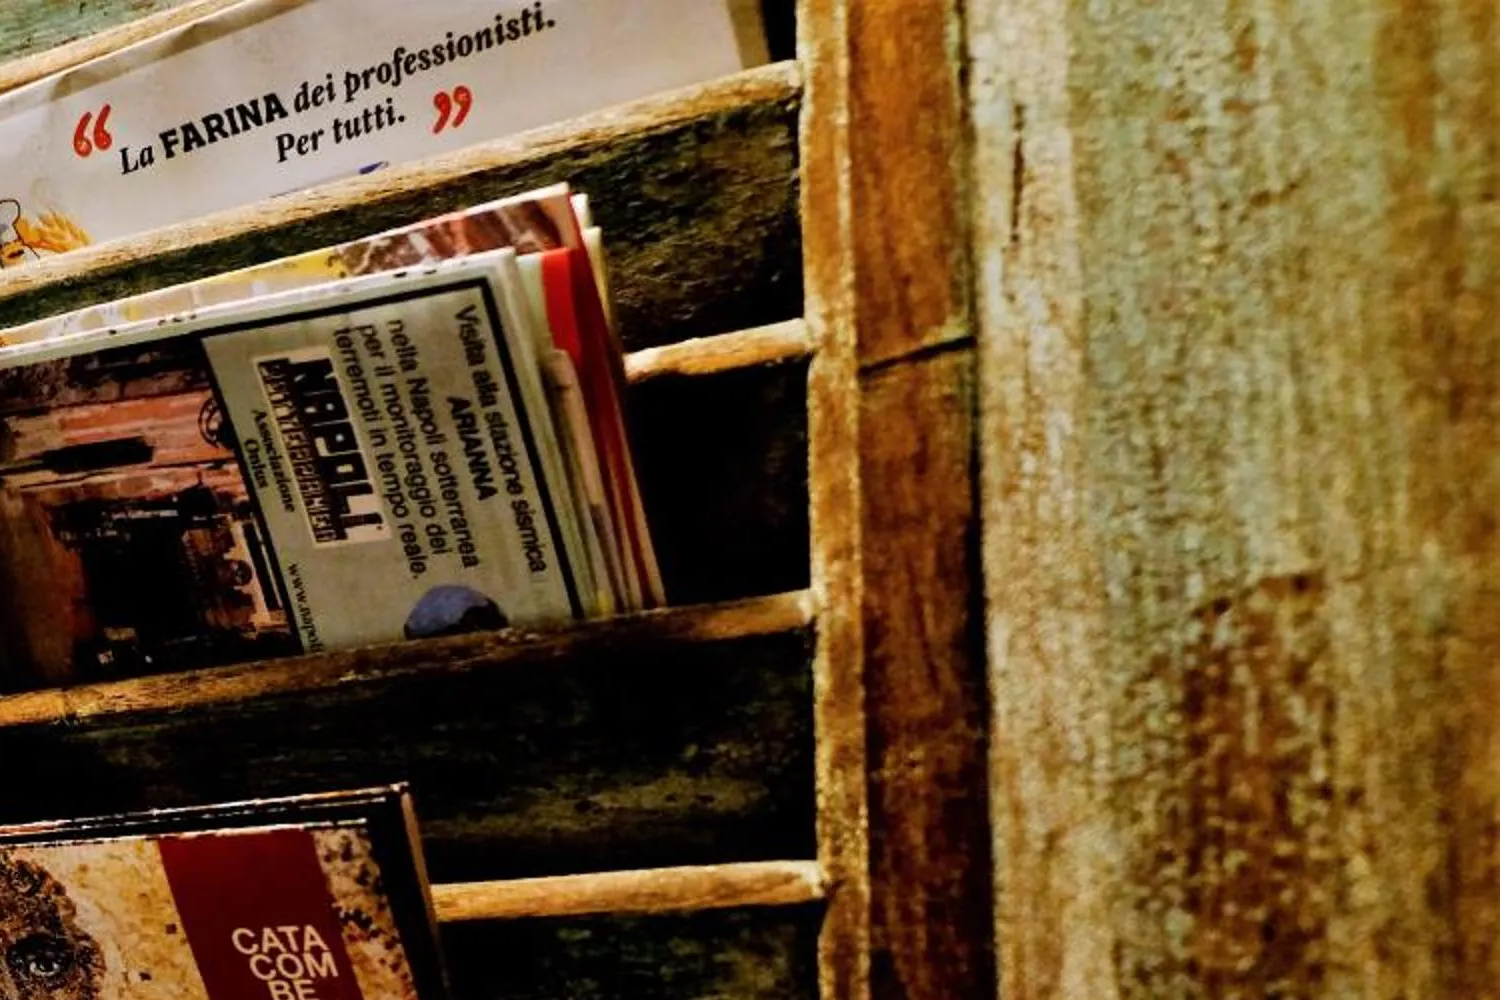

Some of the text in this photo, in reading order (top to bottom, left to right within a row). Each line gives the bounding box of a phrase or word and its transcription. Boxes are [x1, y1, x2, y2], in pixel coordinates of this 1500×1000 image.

[119, 2, 555, 176] La FARINA dei professionisti.
[275, 100, 406, 163] Per tutti.
[334, 328, 382, 423] terremoti
[253, 410, 297, 513] Associazione
[288, 358, 383, 531] NAPOLI
[354, 325, 451, 556] per il monitoraggio dei
[370, 428, 389, 448] in
[373, 453, 409, 517] tempo
[386, 320, 480, 568] nella Napoli sotterranea
[446, 397, 498, 500] ARIANNA
[454, 305, 547, 573] Visita alla stazione sismica
[231, 925, 329, 954] CATA
[250, 953, 338, 980] COM
